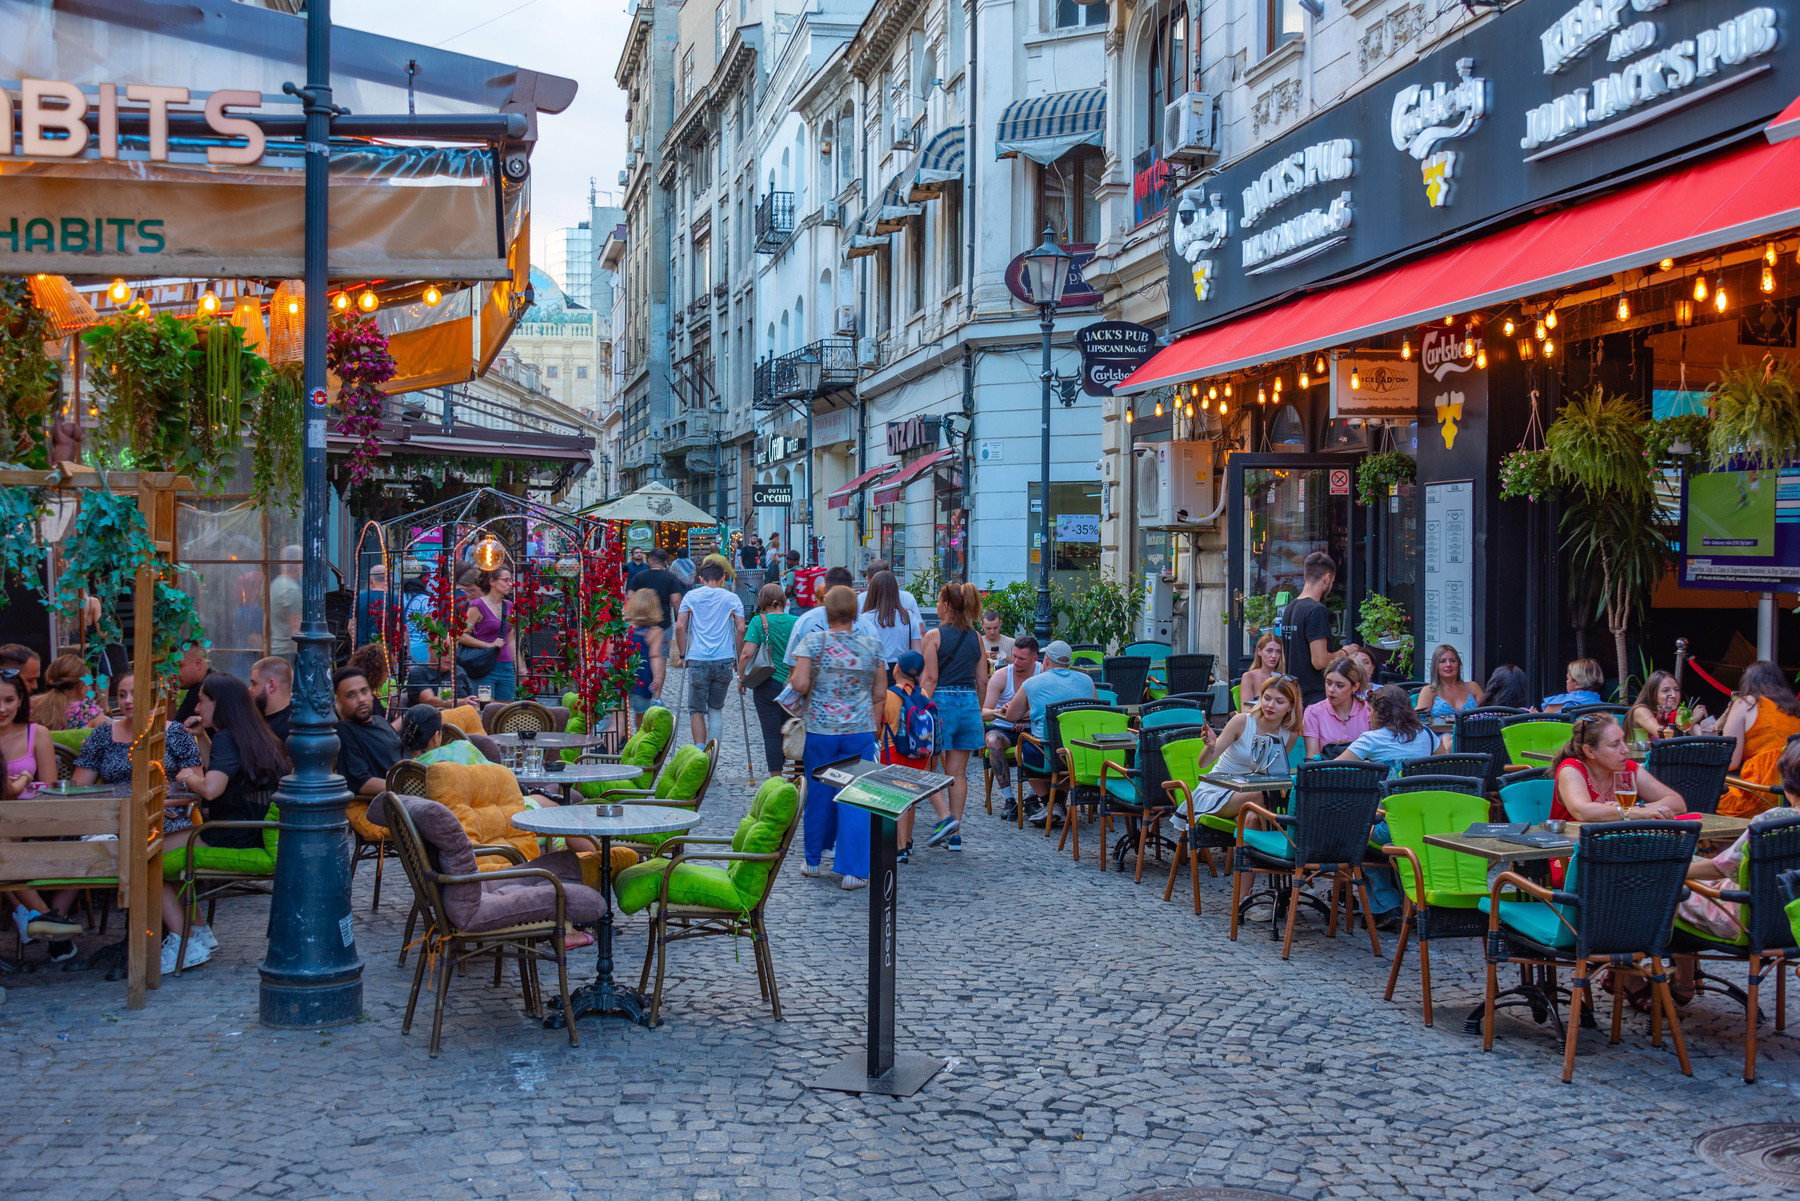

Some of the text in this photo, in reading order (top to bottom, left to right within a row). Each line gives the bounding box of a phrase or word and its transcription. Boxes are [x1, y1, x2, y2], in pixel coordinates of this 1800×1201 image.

[1607, 21, 1656, 62] AND
[1520, 7, 1778, 149] JOIN JACK'S PUB
[1391, 57, 1487, 160] Carlsberg
[1240, 151, 1305, 228] JACK'S
[1304, 139, 1353, 187] PUB
[0, 217, 167, 254] HABITS
[1084, 329, 1149, 343] JACK'S PUB
[1087, 344, 1146, 353] LIPSCANI No.45
[1091, 365, 1133, 388] Carlsbe
[754, 492, 791, 503] Cream
[1072, 525, 1099, 535] -35%
[884, 905, 892, 967] pepsi
